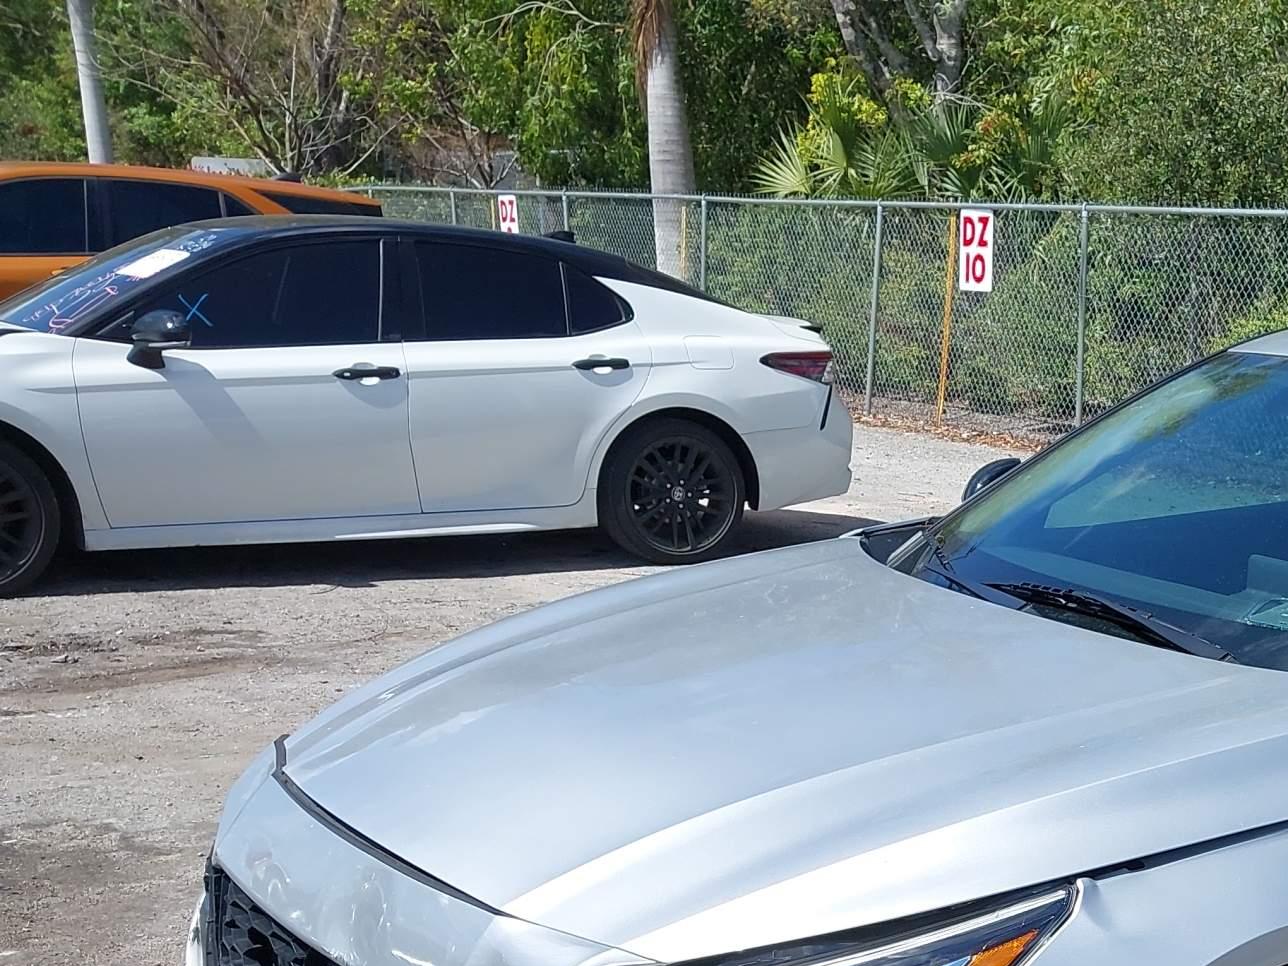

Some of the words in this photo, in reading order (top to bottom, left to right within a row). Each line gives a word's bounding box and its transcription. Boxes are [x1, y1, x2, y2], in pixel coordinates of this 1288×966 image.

[500, 200, 516, 223] DZ
[963, 216, 990, 247] DZ
[965, 252, 986, 284] 10
